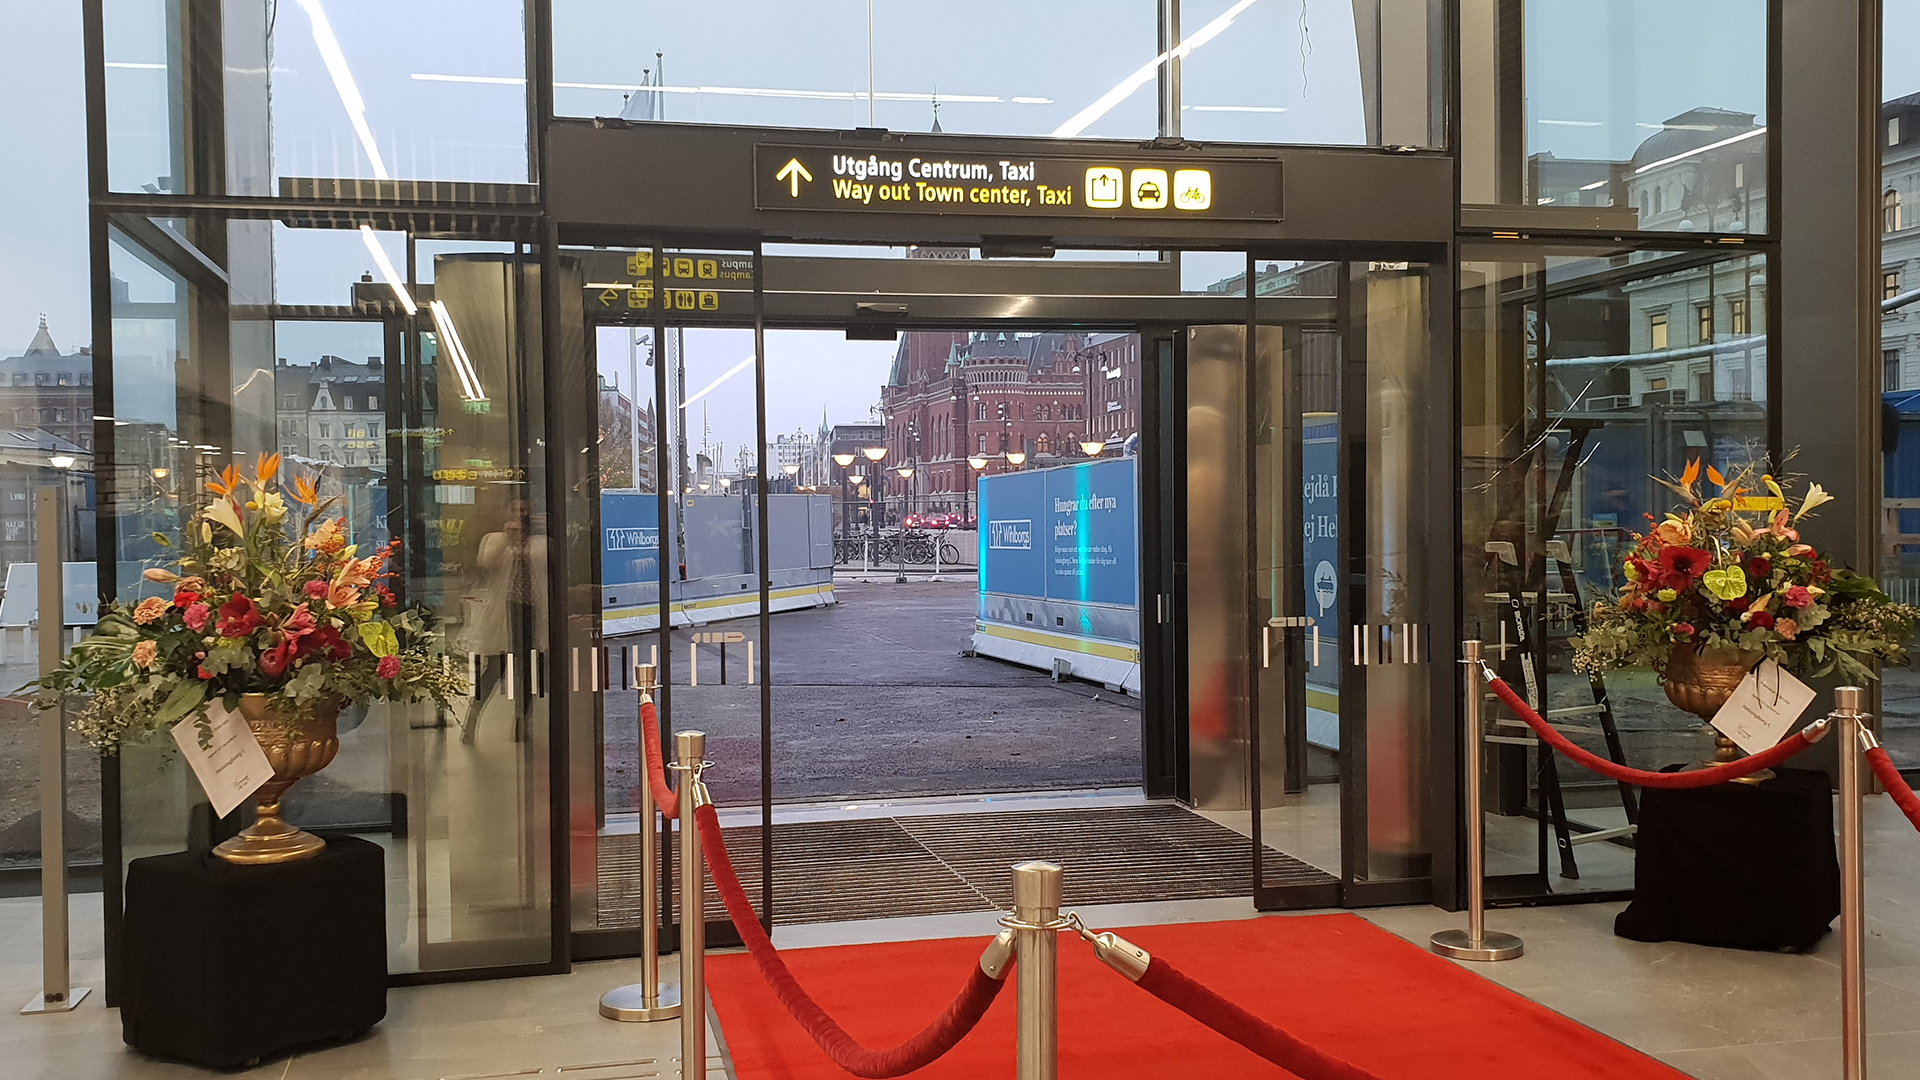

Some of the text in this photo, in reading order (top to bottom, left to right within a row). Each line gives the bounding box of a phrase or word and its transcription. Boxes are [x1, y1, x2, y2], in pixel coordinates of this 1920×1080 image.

[833, 154, 1035, 183] Utgång Centrum, Taxi
[832, 179, 1072, 207] Way out Town center, Taxi
[1303, 474, 1329, 504] ejdå
[1054, 492, 1117, 516] Hungrar du efter nya
[1003, 525, 1030, 547] Wihlborgs
[1054, 519, 1078, 541] platser?
[1303, 514, 1315, 544] ej
